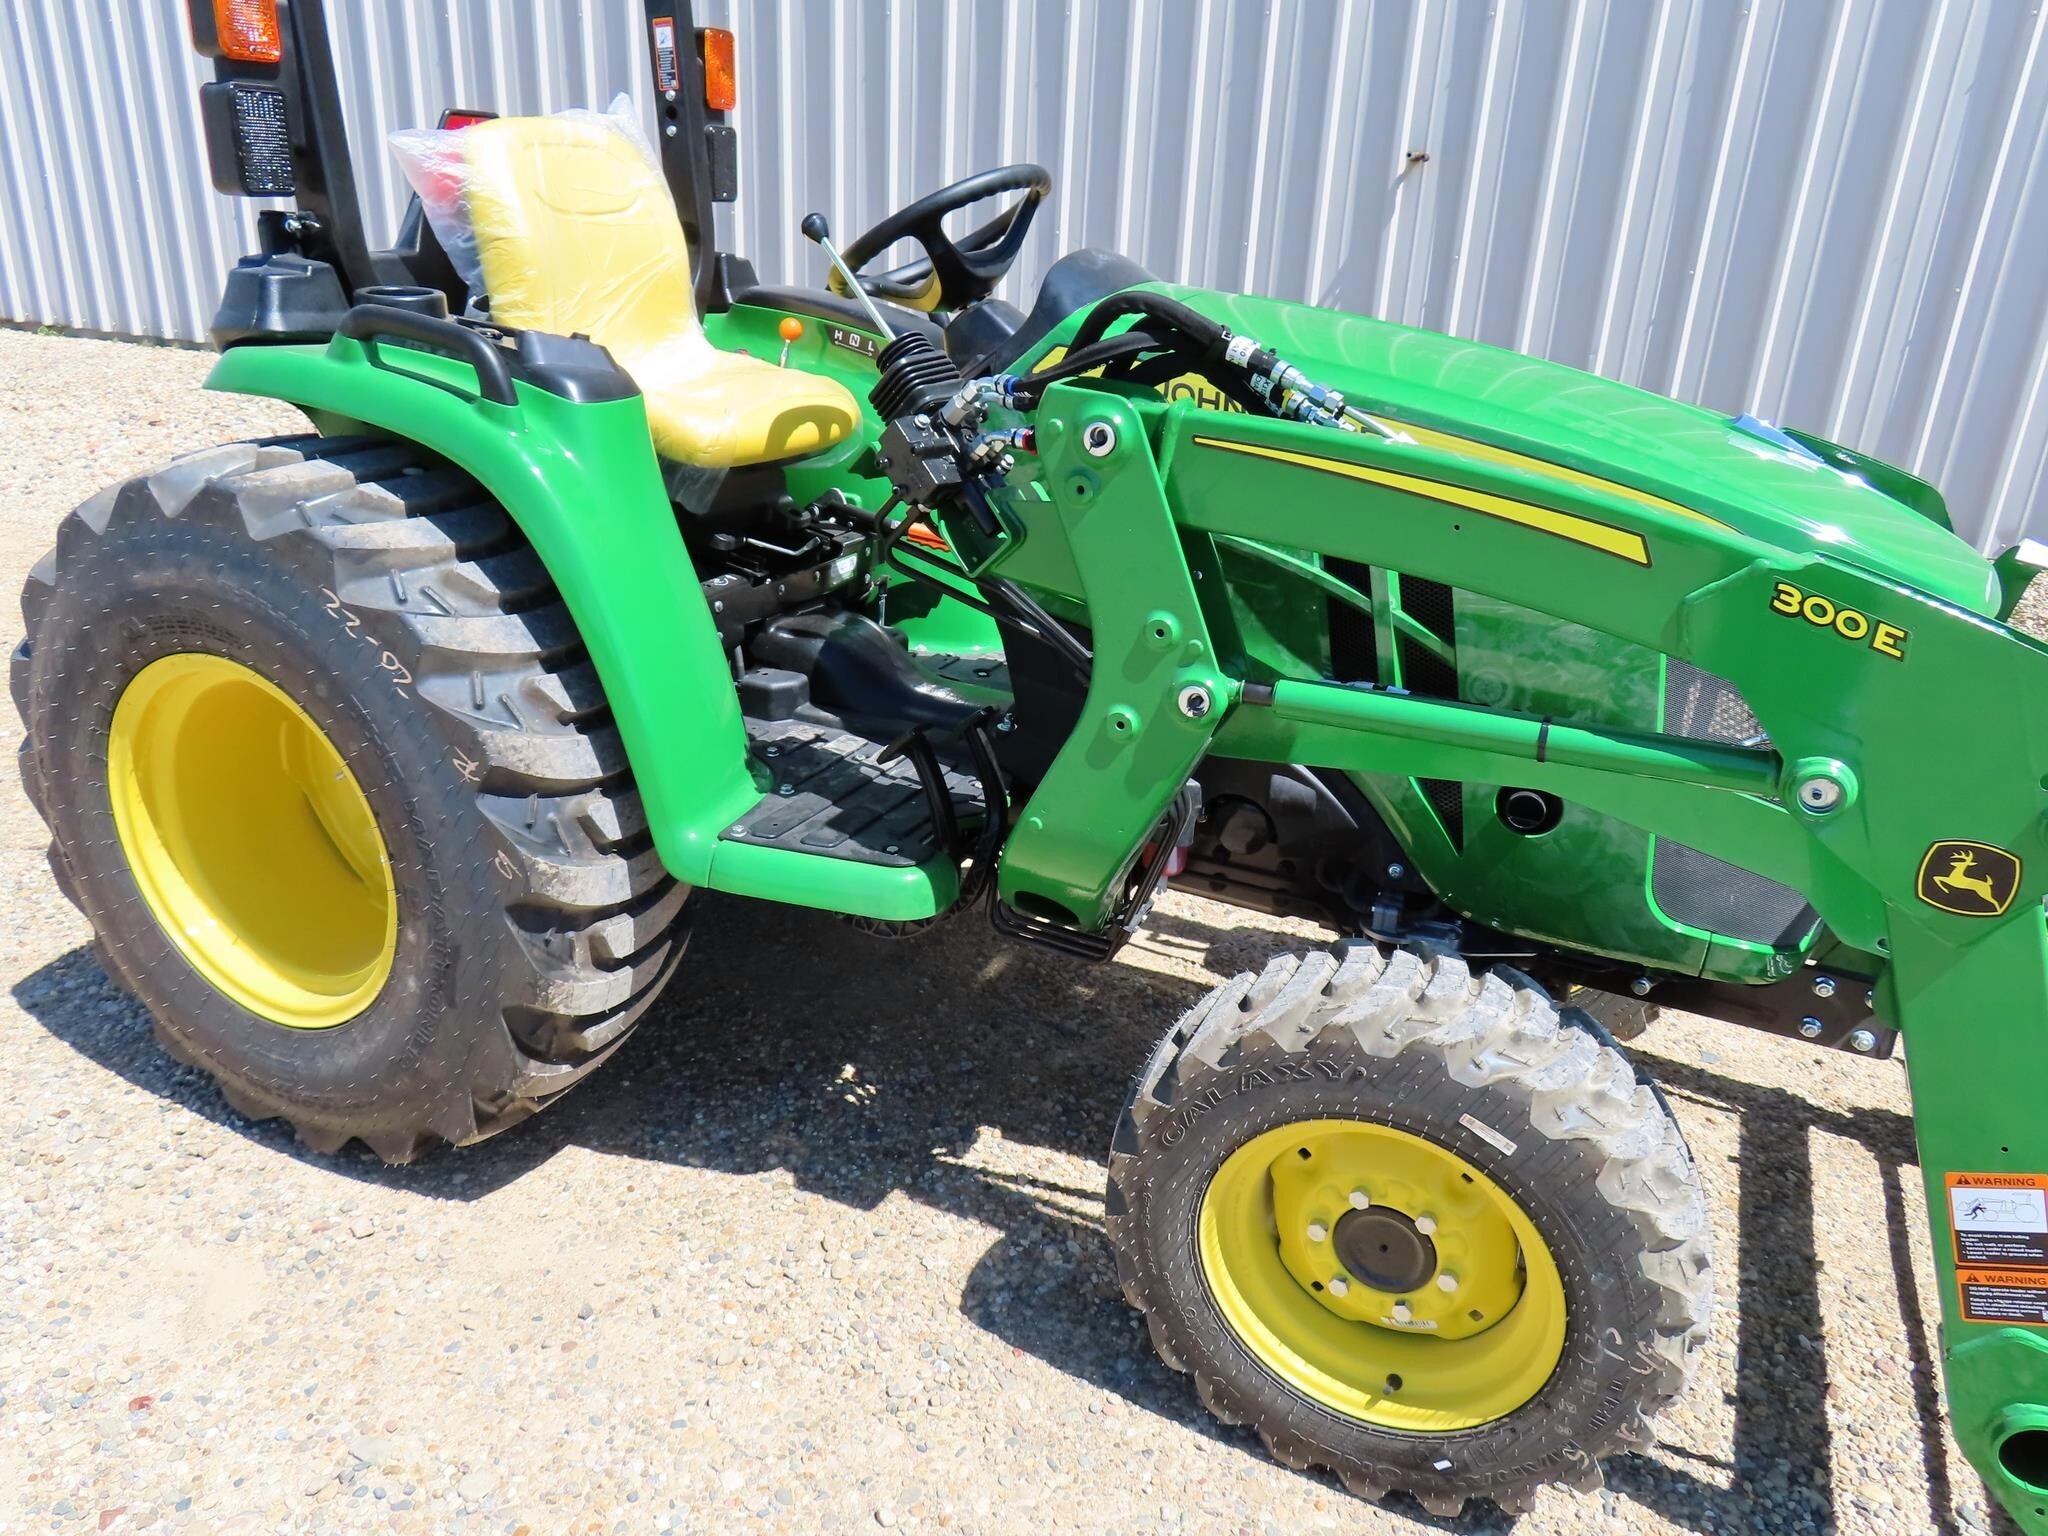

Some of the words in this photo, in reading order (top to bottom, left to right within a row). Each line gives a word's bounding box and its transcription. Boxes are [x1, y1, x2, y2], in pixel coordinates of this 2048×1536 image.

[834, 330, 843, 340] H
[868, 341, 874, 351] L
[1162, 1060, 1354, 1146] GALAXY
[1972, 1176, 2036, 1187] WARNING
[1984, 1275, 2047, 1286] WARNING
